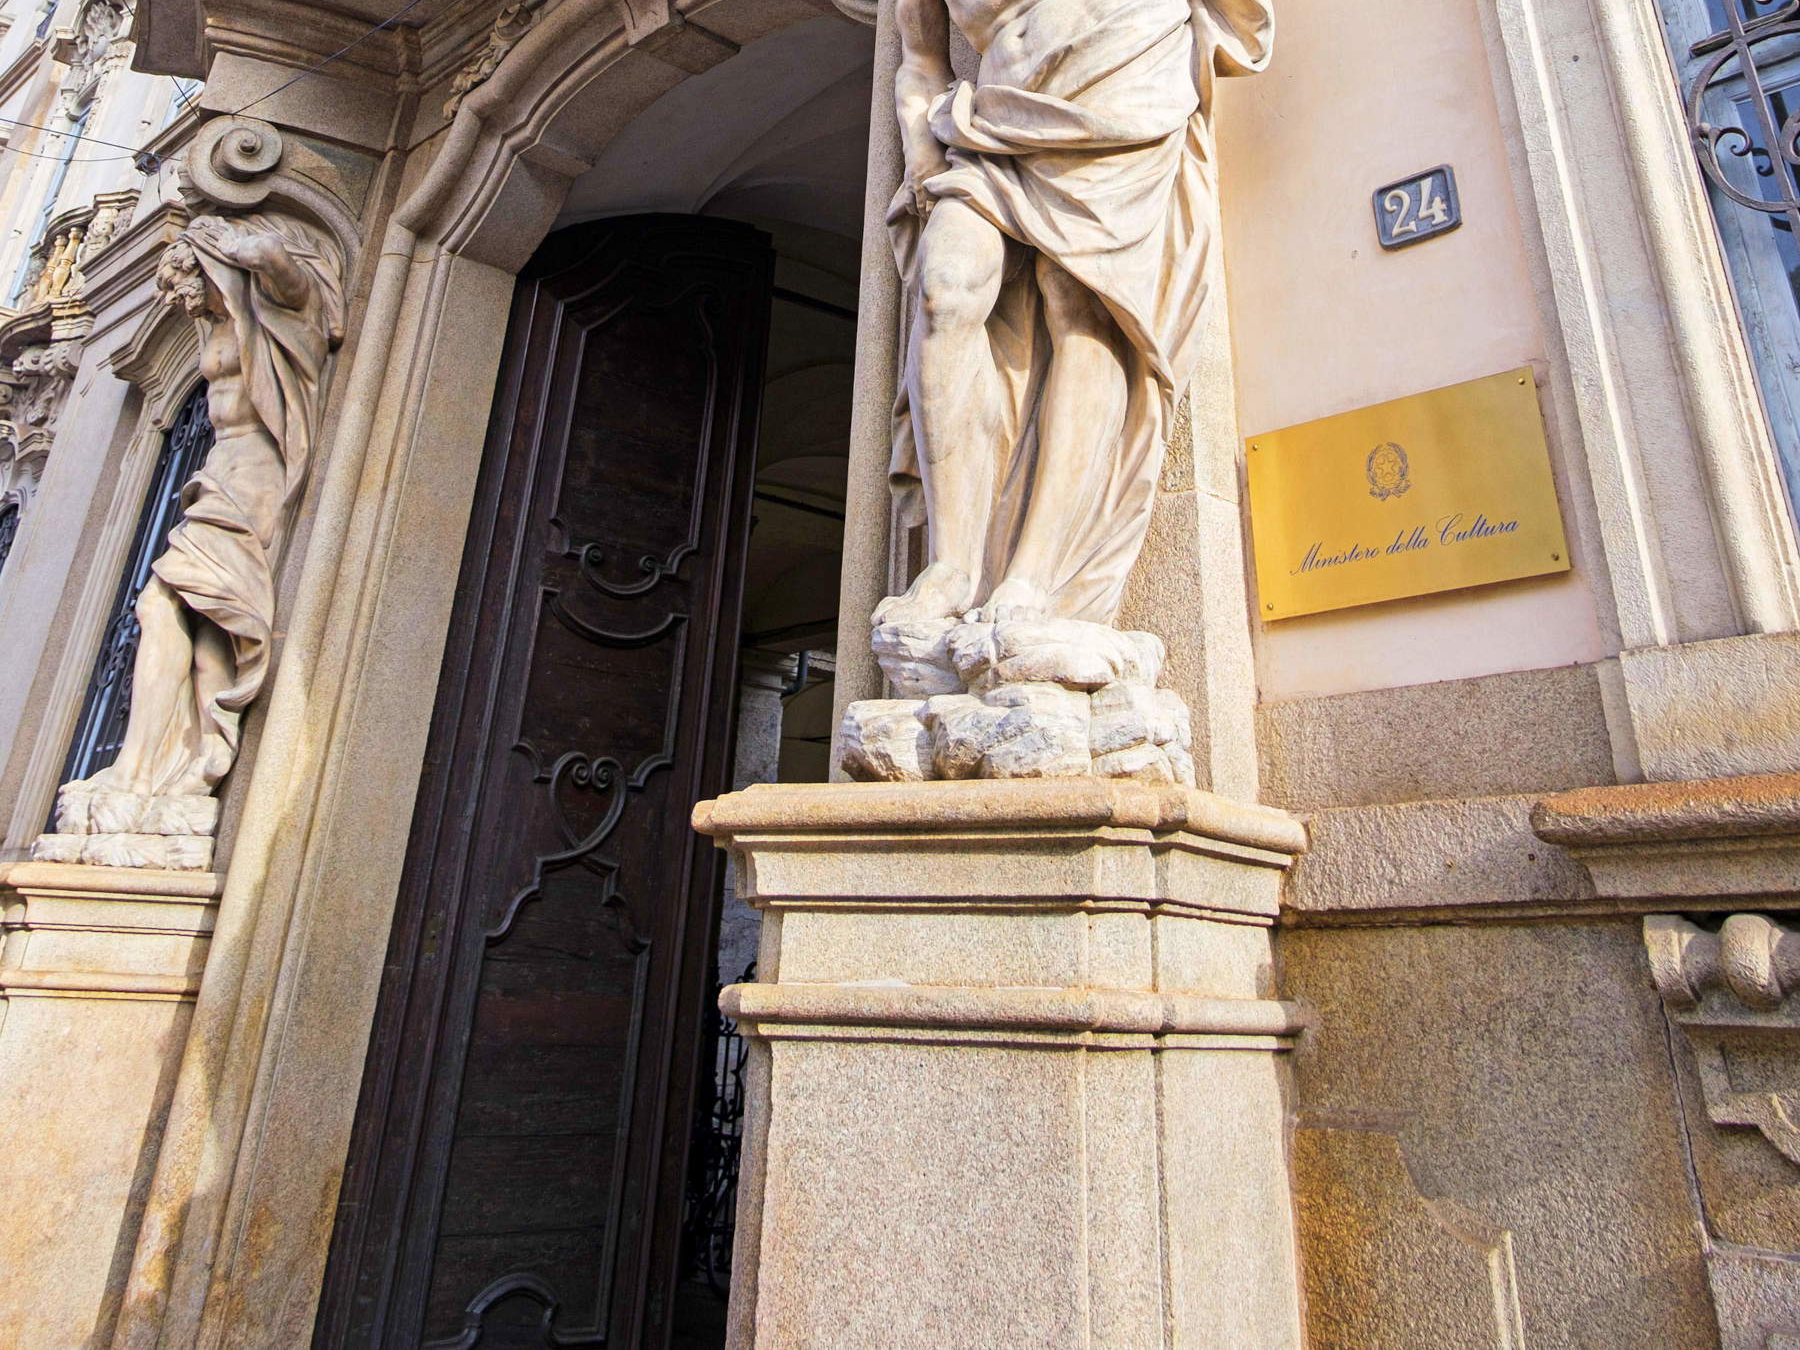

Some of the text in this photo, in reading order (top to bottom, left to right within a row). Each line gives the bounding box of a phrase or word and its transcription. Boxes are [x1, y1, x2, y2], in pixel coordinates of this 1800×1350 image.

[1384, 177, 1449, 237] 24
[1289, 512, 1520, 576] Ministero della Cultura
